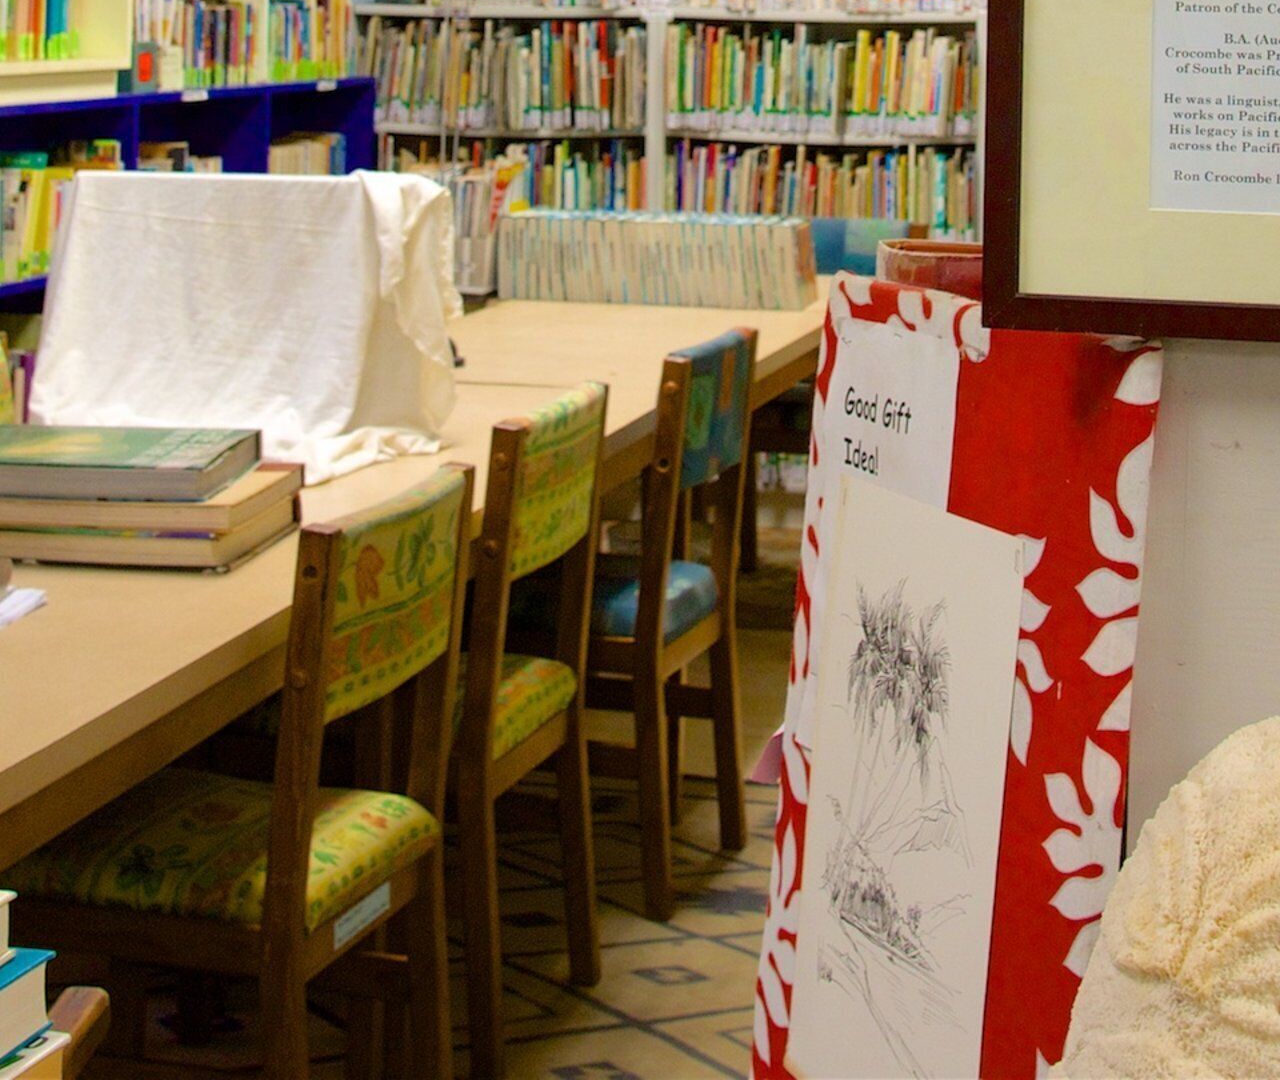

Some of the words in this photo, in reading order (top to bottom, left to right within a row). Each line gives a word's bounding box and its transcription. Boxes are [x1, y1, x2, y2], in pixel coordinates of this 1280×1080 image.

[1176, 1, 1220, 12] Patron
[1224, 2, 1238, 13] of
[1241, 2, 1262, 13] the
[1224, 33, 1250, 44] B.A.
[1164, 47, 1232, 59] Crocombe
[1176, 63, 1190, 73] of
[1193, 63, 1232, 74] South
[1164, 93, 1181, 103] He
[1186, 96, 1211, 104] was
[1173, 109, 1213, 119] works
[1217, 112, 1233, 120] on
[1169, 123, 1190, 134] His
[1195, 124, 1237, 138] legacy
[1242, 126, 1252, 136] is
[1257, 126, 1269, 137] in
[1169, 142, 1211, 150] across
[1215, 141, 1236, 151] the
[1174, 170, 1199, 181] Ron
[1204, 171, 1271, 183] Crocombe
[844, 386, 878, 423] Good
[882, 397, 912, 435] Gift
[843, 437, 879, 476] Idea!
